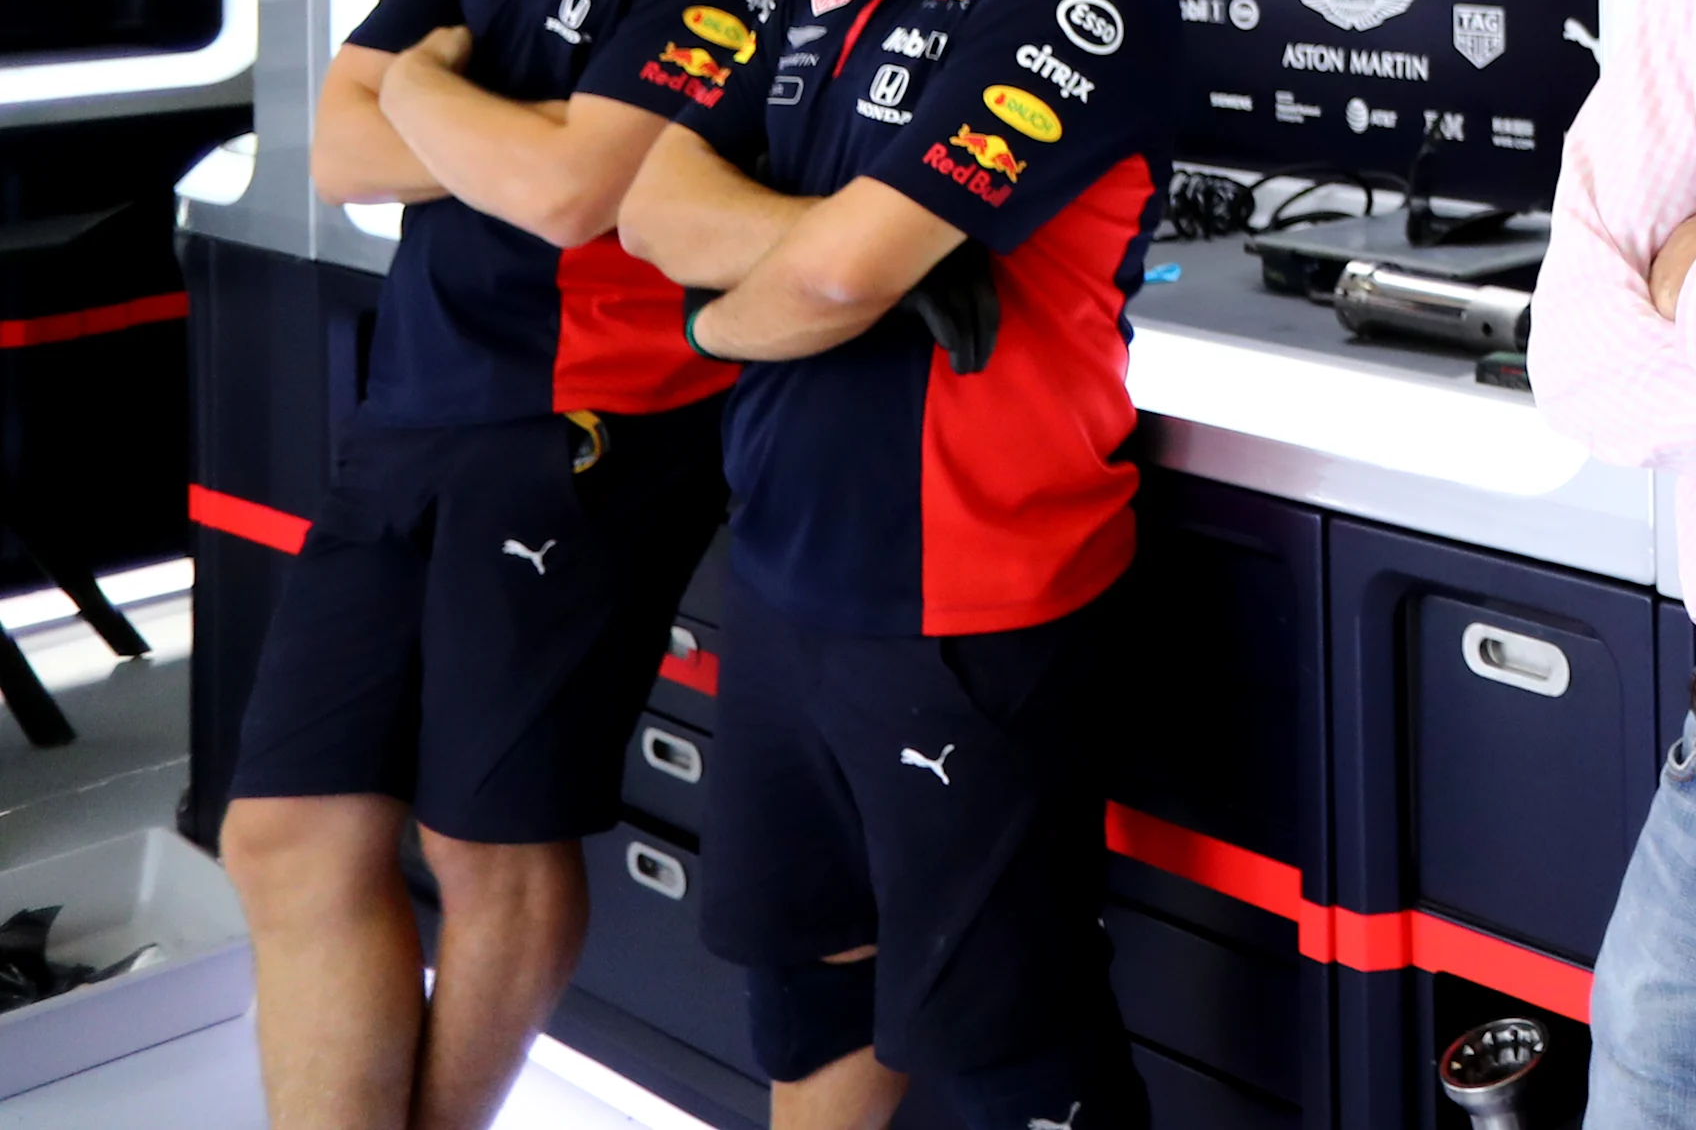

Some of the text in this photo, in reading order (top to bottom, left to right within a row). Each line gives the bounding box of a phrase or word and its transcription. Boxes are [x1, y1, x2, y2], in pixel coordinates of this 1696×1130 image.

[1458, 12, 1499, 32] TAG
[1282, 41, 1429, 83] ASTON MARTIN
